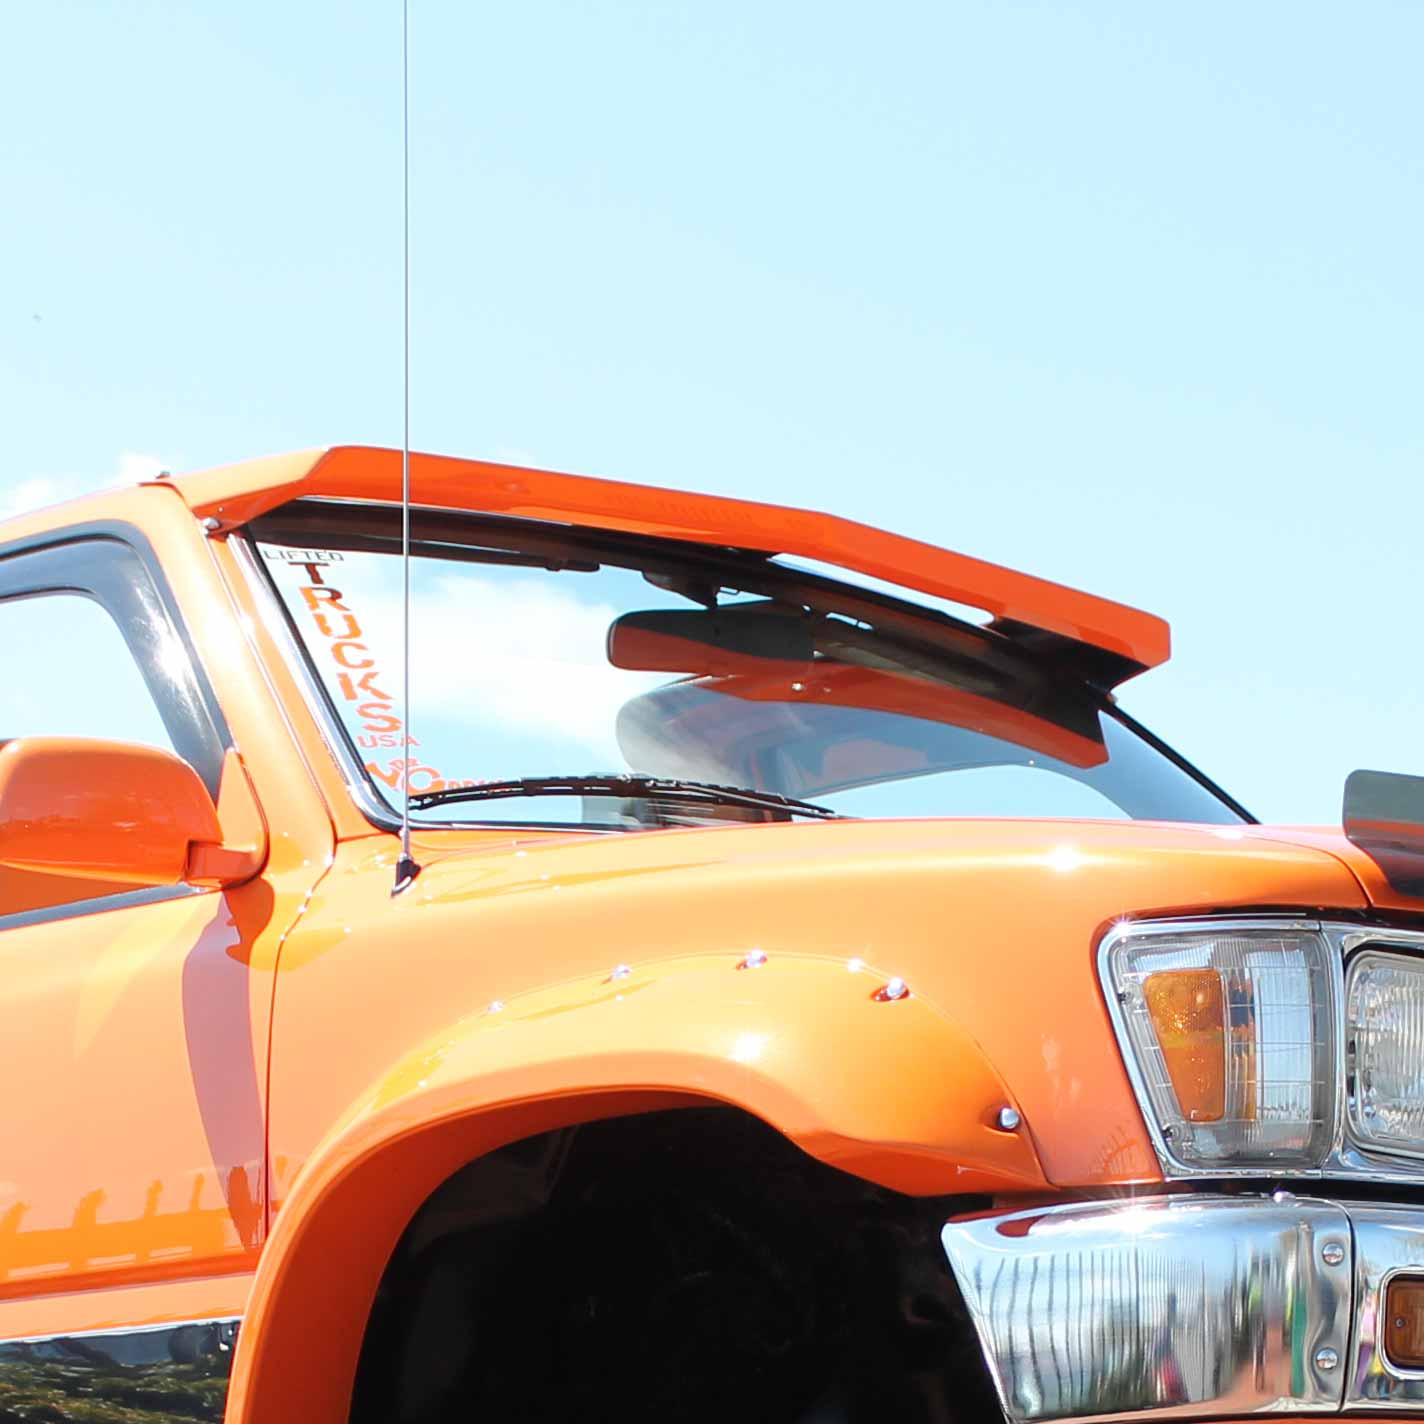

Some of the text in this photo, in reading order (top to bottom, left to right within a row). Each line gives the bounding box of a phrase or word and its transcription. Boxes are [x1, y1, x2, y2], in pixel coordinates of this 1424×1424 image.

[262, 549, 345, 562] LIFTED
[287, 561, 403, 732] TRUCKS
[356, 734, 421, 749] USA
